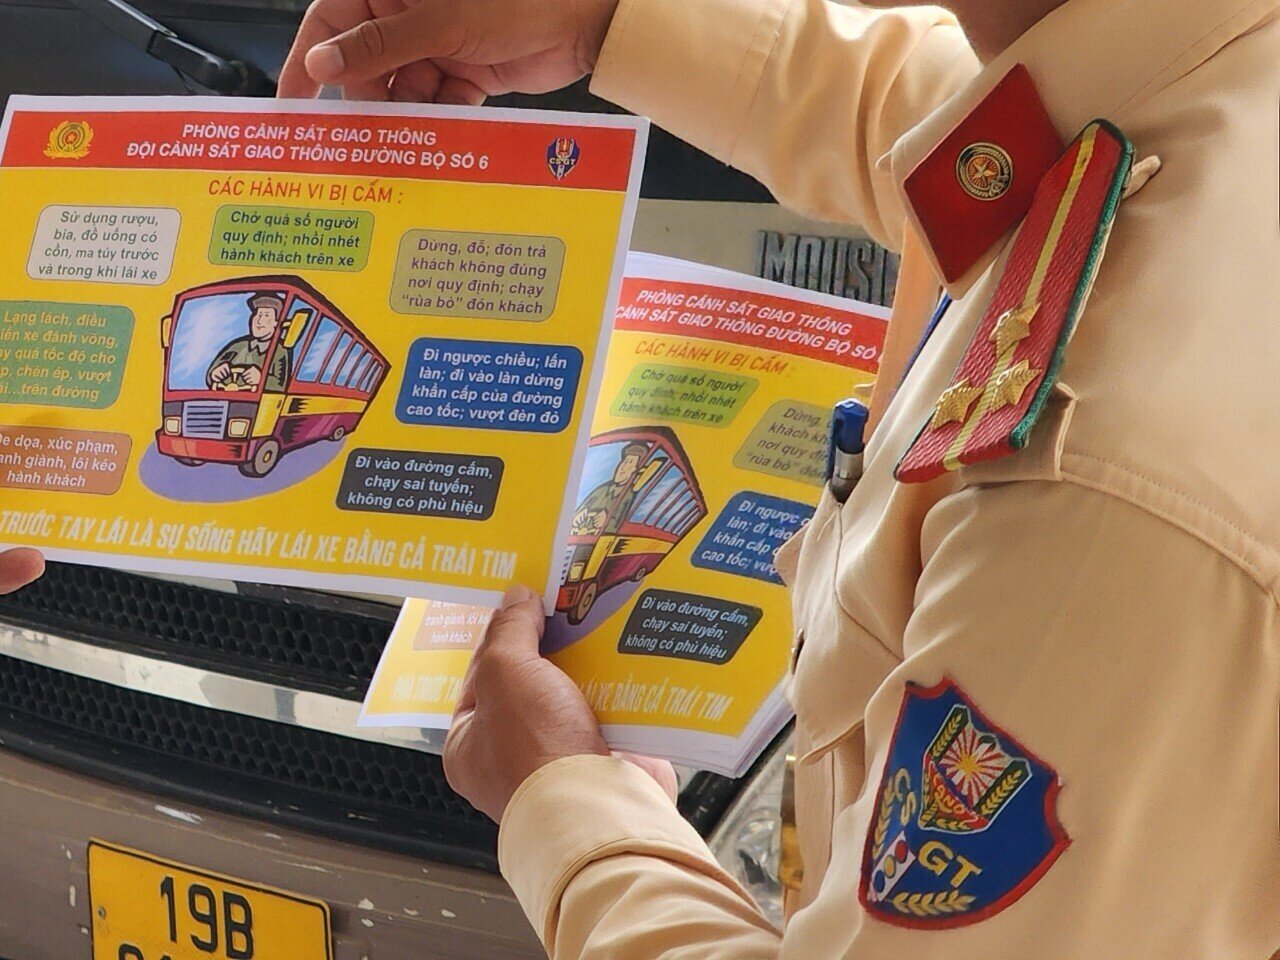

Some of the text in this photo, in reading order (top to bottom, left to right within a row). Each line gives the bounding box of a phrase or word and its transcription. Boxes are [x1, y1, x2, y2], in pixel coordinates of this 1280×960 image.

[182, 124, 436, 145] PHÒNG CẢNH SÁT GIAO THÔNG
[127, 142, 155, 158] ĐỘI
[159, 142, 204, 158] CẢNH
[208, 142, 240, 158] SÁT
[245, 145, 284, 159] GIAO
[290, 144, 347, 162] THÔNG
[351, 146, 416, 165] ĐƯỜNG
[420, 150, 445, 168] BỘ
[479, 155, 489, 169] 6
[209, 176, 244, 195] CÁC
[249, 176, 301, 197] HÀNH
[309, 184, 326, 198] VI
[329, 186, 346, 206] BỊ
[352, 182, 394, 203] CẤM
[60, 211, 159, 227] Sử dụng rượu,
[231, 211, 359, 230] Chở quá số người
[54, 227, 157, 244] bia, đồ uống có
[223, 231, 360, 248] quy định; nhồi nhét
[44, 243, 159, 261] cồn, ma túy trước
[221, 248, 355, 266] hành khách trên xe
[418, 239, 461, 255] Dừng,
[495, 244, 522, 257] đón
[527, 245, 546, 258] trả
[38, 263, 157, 279] và trong khi lái xe
[412, 258, 547, 280] khách không đúng
[408, 277, 544, 298] nơi quy định; chạy
[467, 298, 494, 311] đón
[499, 300, 543, 314] khách
[637, 290, 853, 336] PHÒNG CẢNH SÁT GIAO THÔNG
[423, 348, 567, 369] Đi ngược chiều; lấn
[419, 366, 564, 390] làn; đi vào làn dừng
[412, 383, 563, 408] khẩn cấp của đường
[407, 403, 559, 424] cao tốc; vượt đèn đỏ
[355, 456, 493, 480] Đi vào đường cấm,
[365, 475, 474, 496] chạy sai tuyến;
[347, 492, 484, 516] không có phù hiệu
[58, 515, 97, 540] TAY
[95, 515, 130, 545] LÁI
[279, 529, 312, 560] LÁI
[314, 535, 341, 562] XE
[343, 528, 396, 567] BẰNG
[399, 535, 426, 570] CẢ
[432, 541, 477, 574] TRÁI
[481, 548, 518, 580] TIM
[159, 875, 254, 960] 19B
